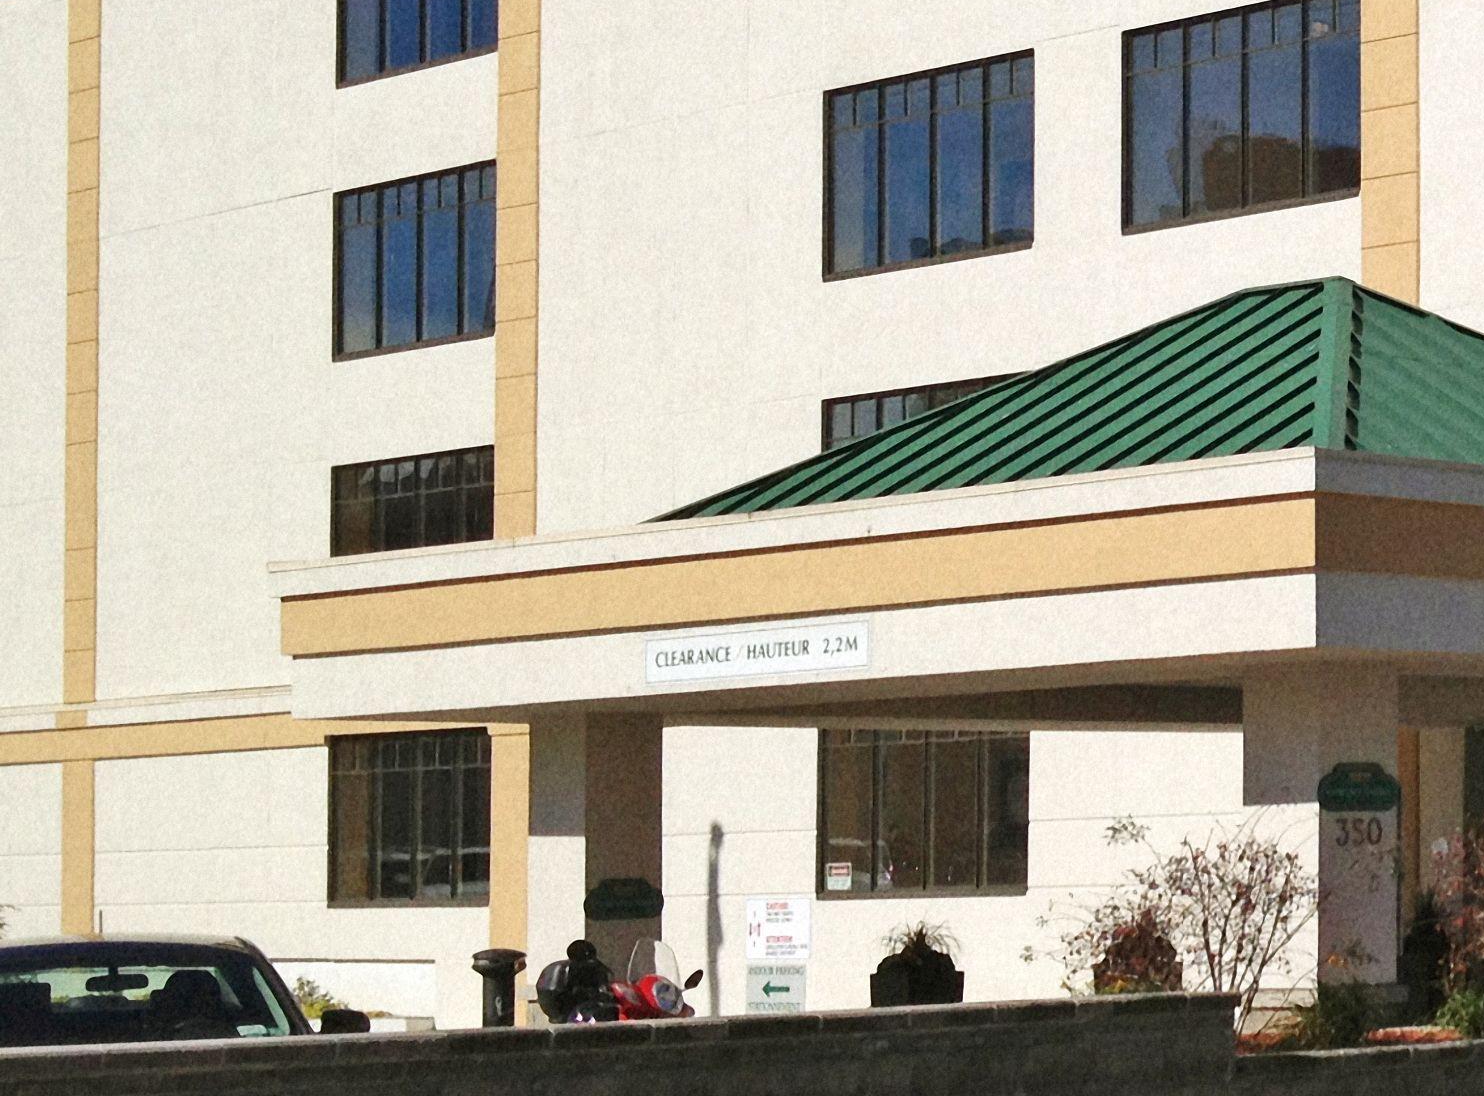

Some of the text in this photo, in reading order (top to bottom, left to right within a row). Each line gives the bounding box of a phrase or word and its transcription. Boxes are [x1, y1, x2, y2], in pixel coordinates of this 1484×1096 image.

[654, 645, 732, 668] CLEARANCE
[746, 639, 810, 661] HAUTEUR
[1335, 816, 1383, 847] 350
